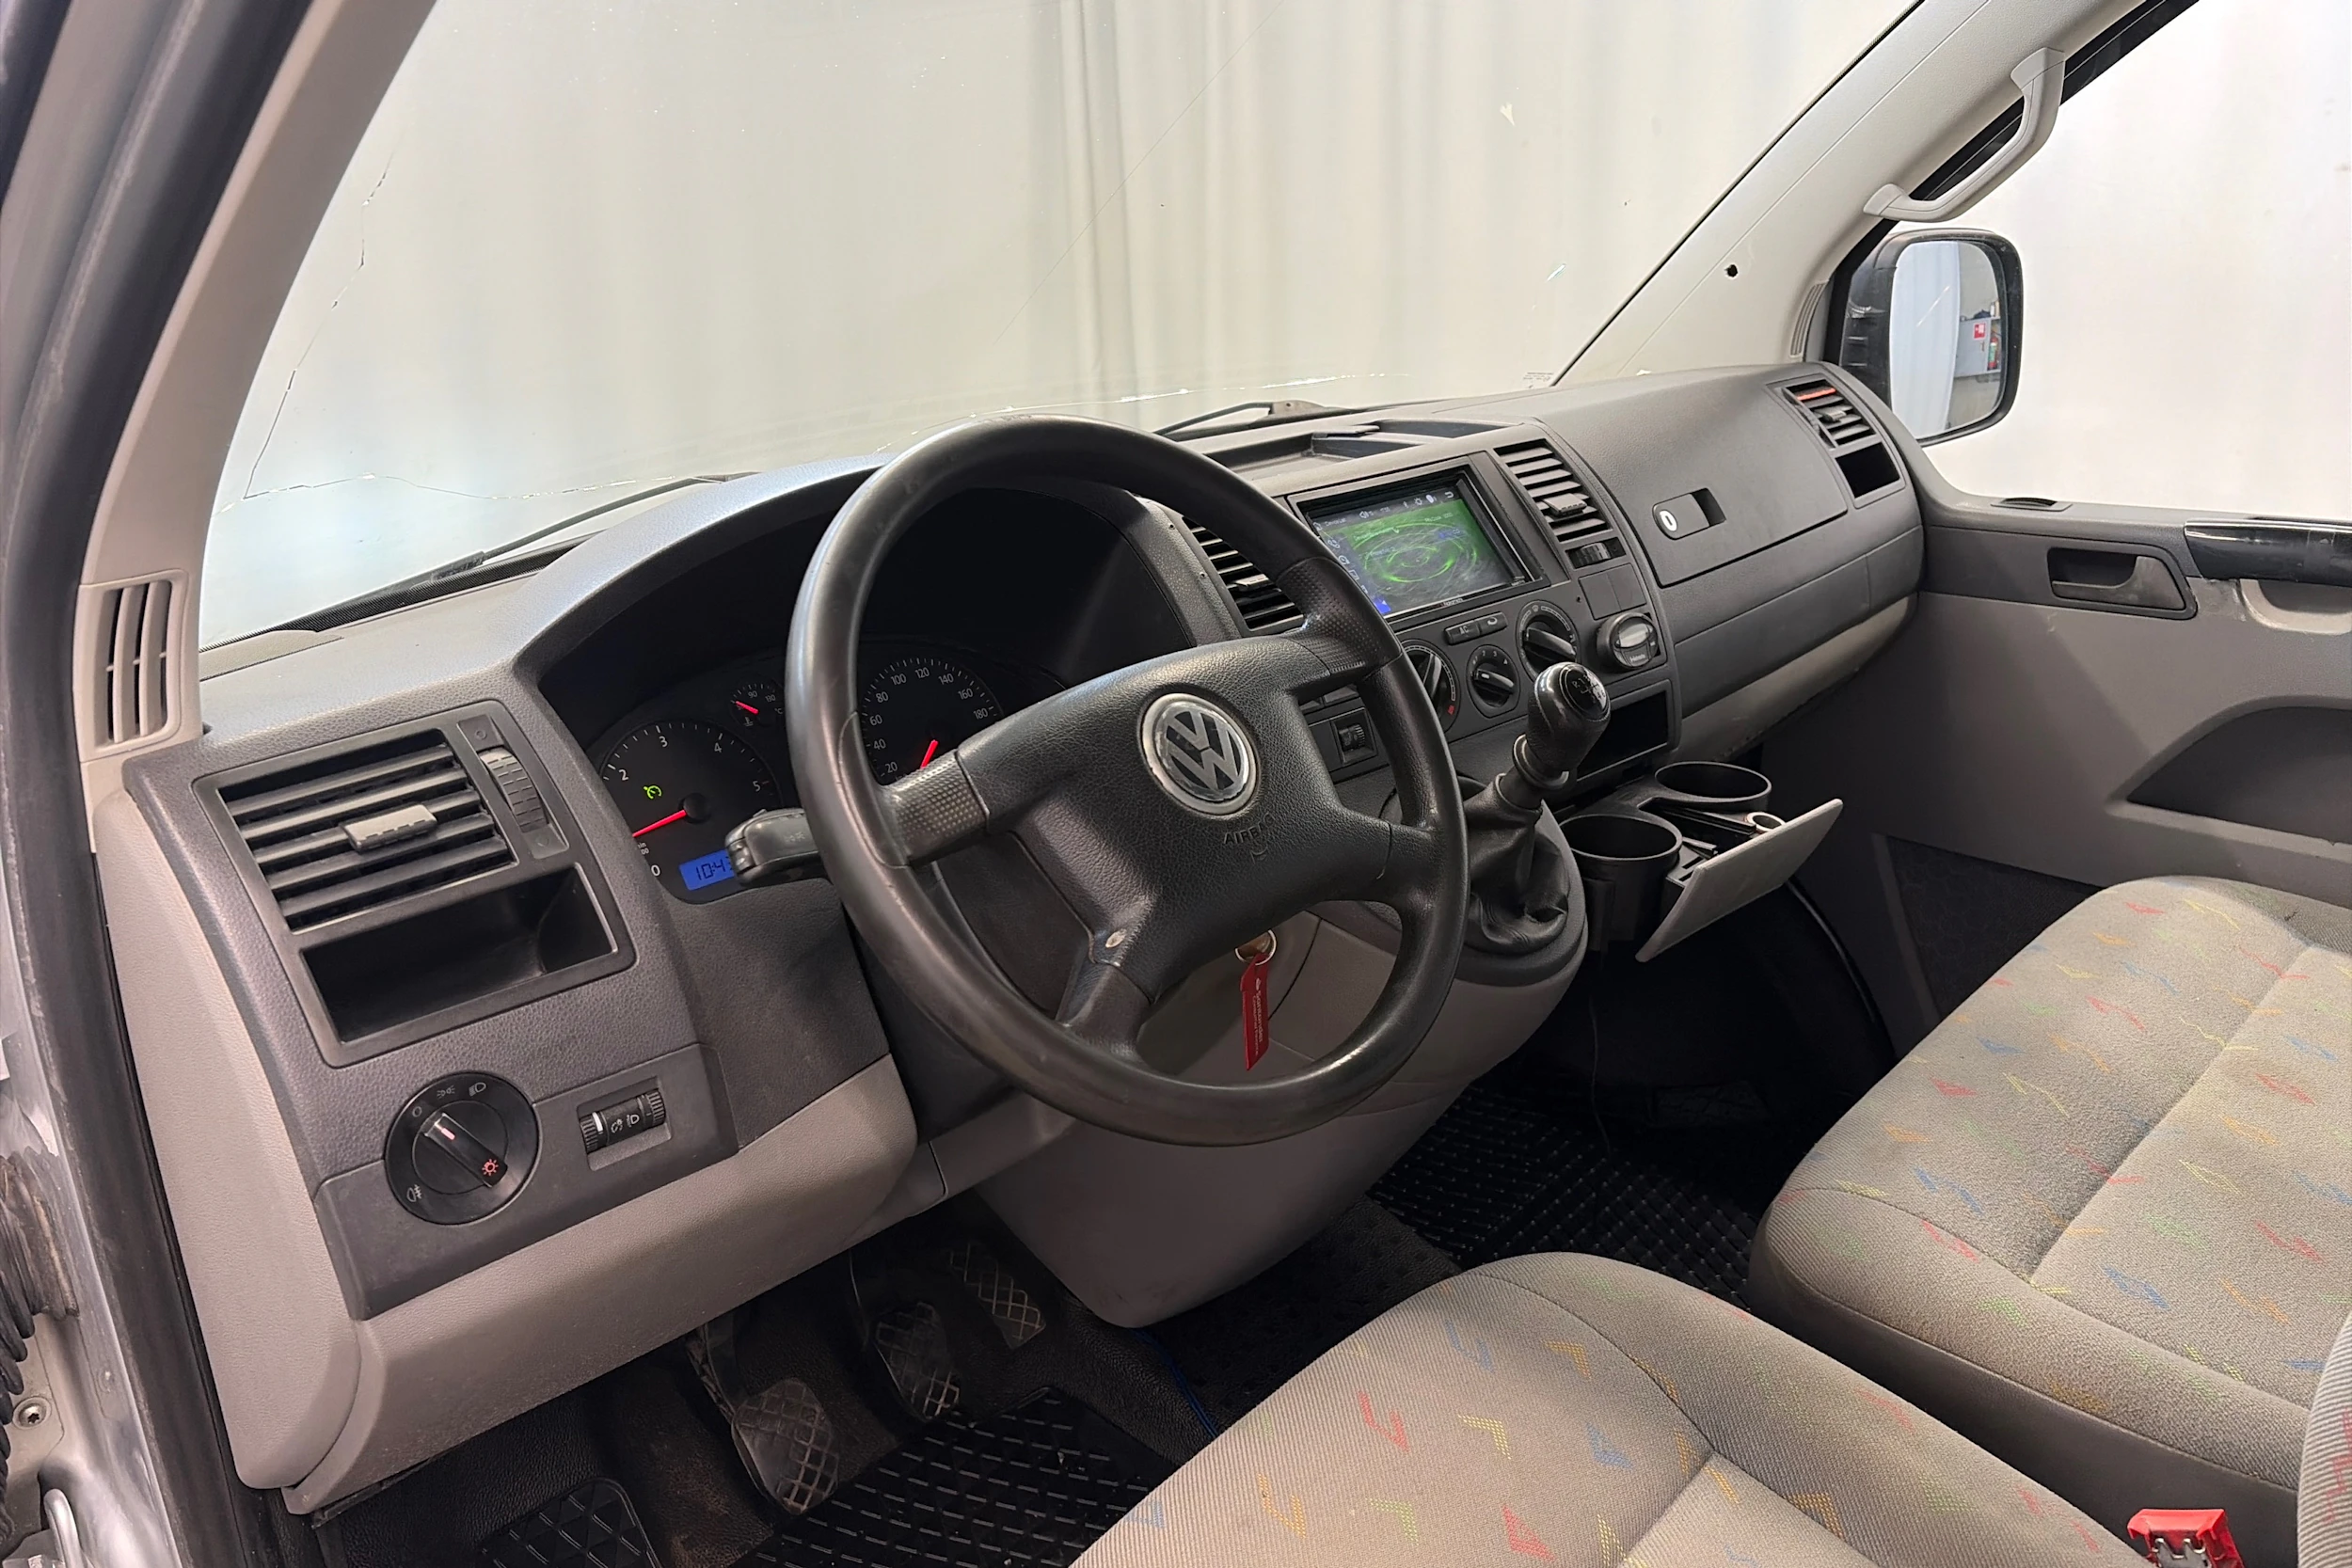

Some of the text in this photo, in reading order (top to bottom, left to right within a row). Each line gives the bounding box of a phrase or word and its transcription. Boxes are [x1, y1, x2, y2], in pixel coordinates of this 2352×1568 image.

[914, 666, 930, 679] 120
[890, 673, 907, 686] 100
[938, 673, 954, 685] 140
[748, 690, 758, 699] 90
[765, 694, 776, 703] 130
[875, 691, 889, 704] 80
[958, 688, 974, 700] 160
[973, 707, 989, 720] 180
[869, 714, 882, 726] 60
[659, 736, 668, 748] 3
[713, 742, 722, 753] 4
[873, 738, 886, 751] 40
[884, 761, 898, 773] 20
[618, 768, 629, 781] 2
[753, 780, 761, 792] 5
[651, 864, 660, 877] 0
